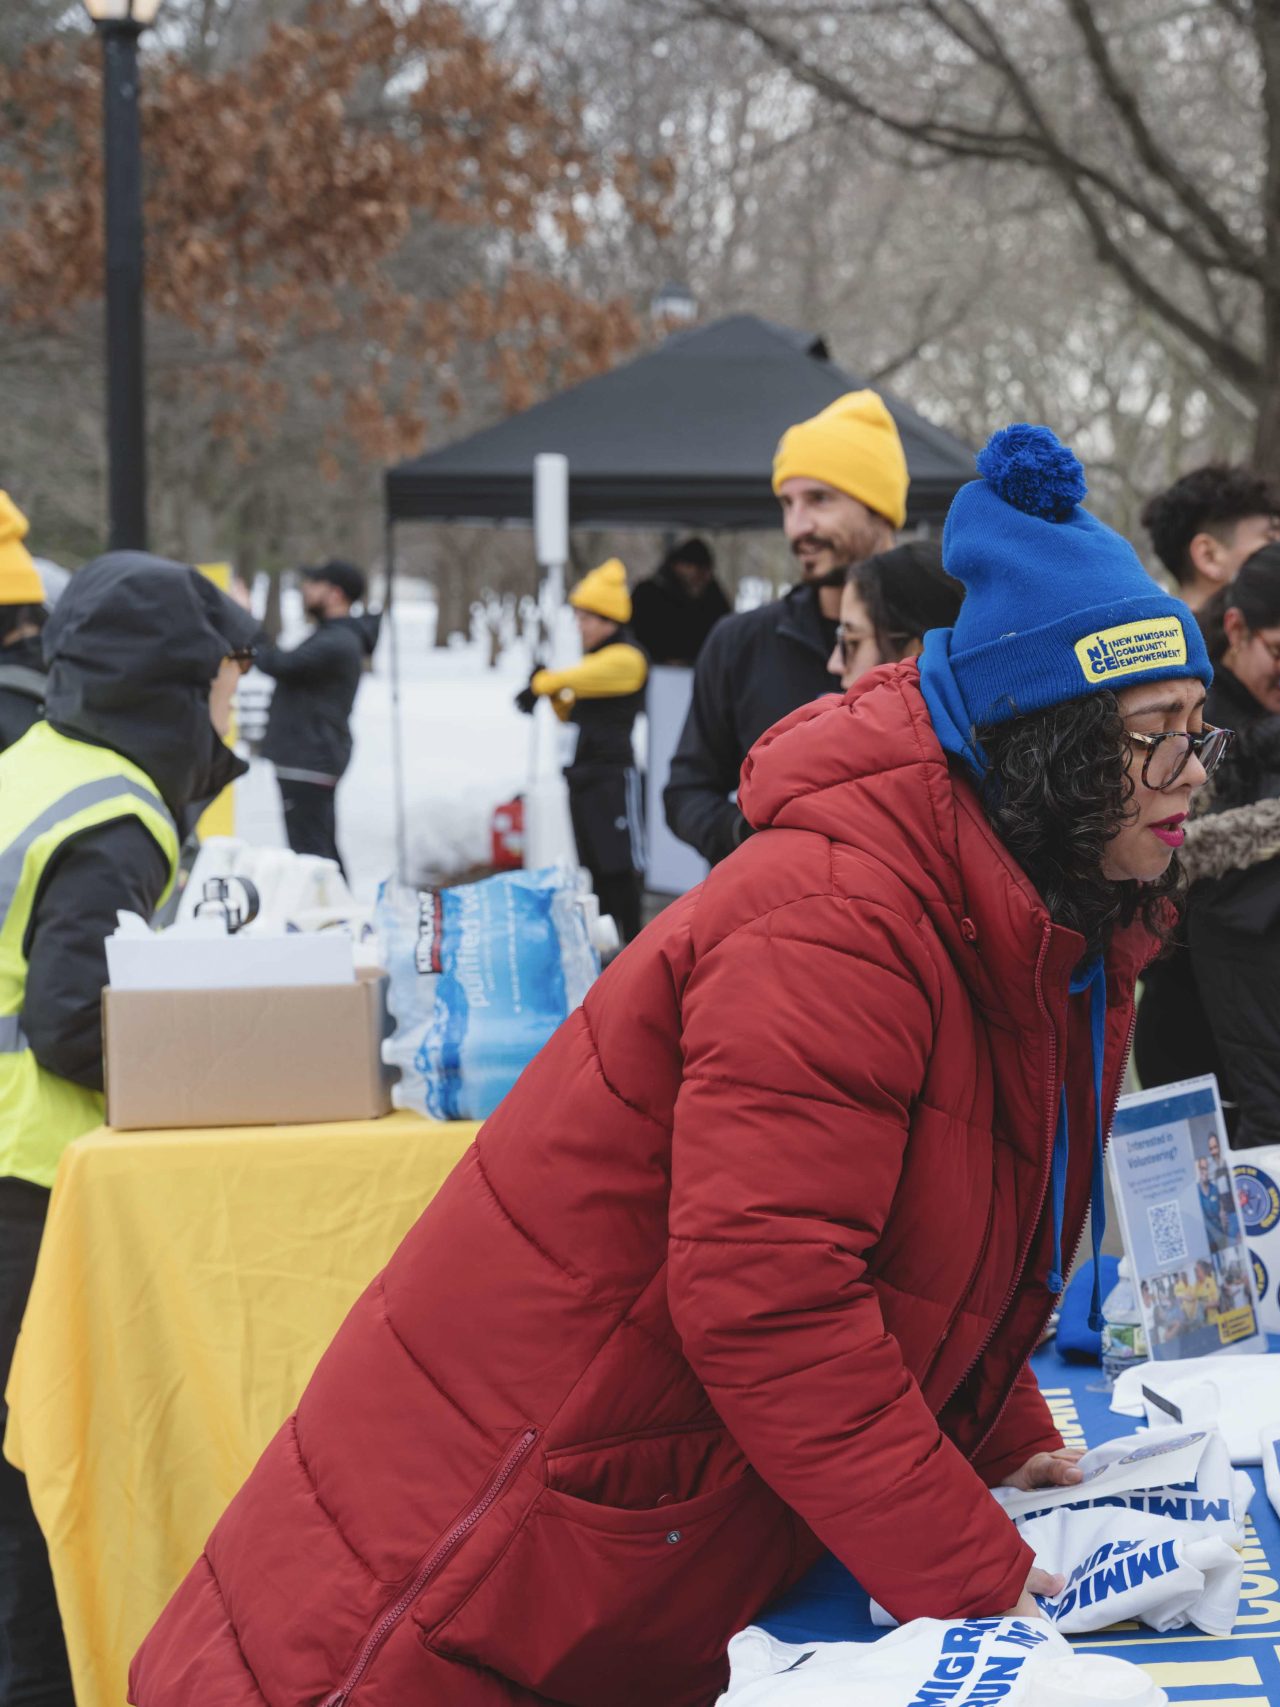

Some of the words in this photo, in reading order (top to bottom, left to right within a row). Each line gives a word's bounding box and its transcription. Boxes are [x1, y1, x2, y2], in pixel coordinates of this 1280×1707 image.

[1112, 636, 1132, 647] NEW
[1133, 629, 1178, 643] IMMIGRANT
[1116, 641, 1167, 657] COMMUNITY
[1119, 650, 1180, 667] EMPOWERMENT
[456, 918, 490, 1008] purified
